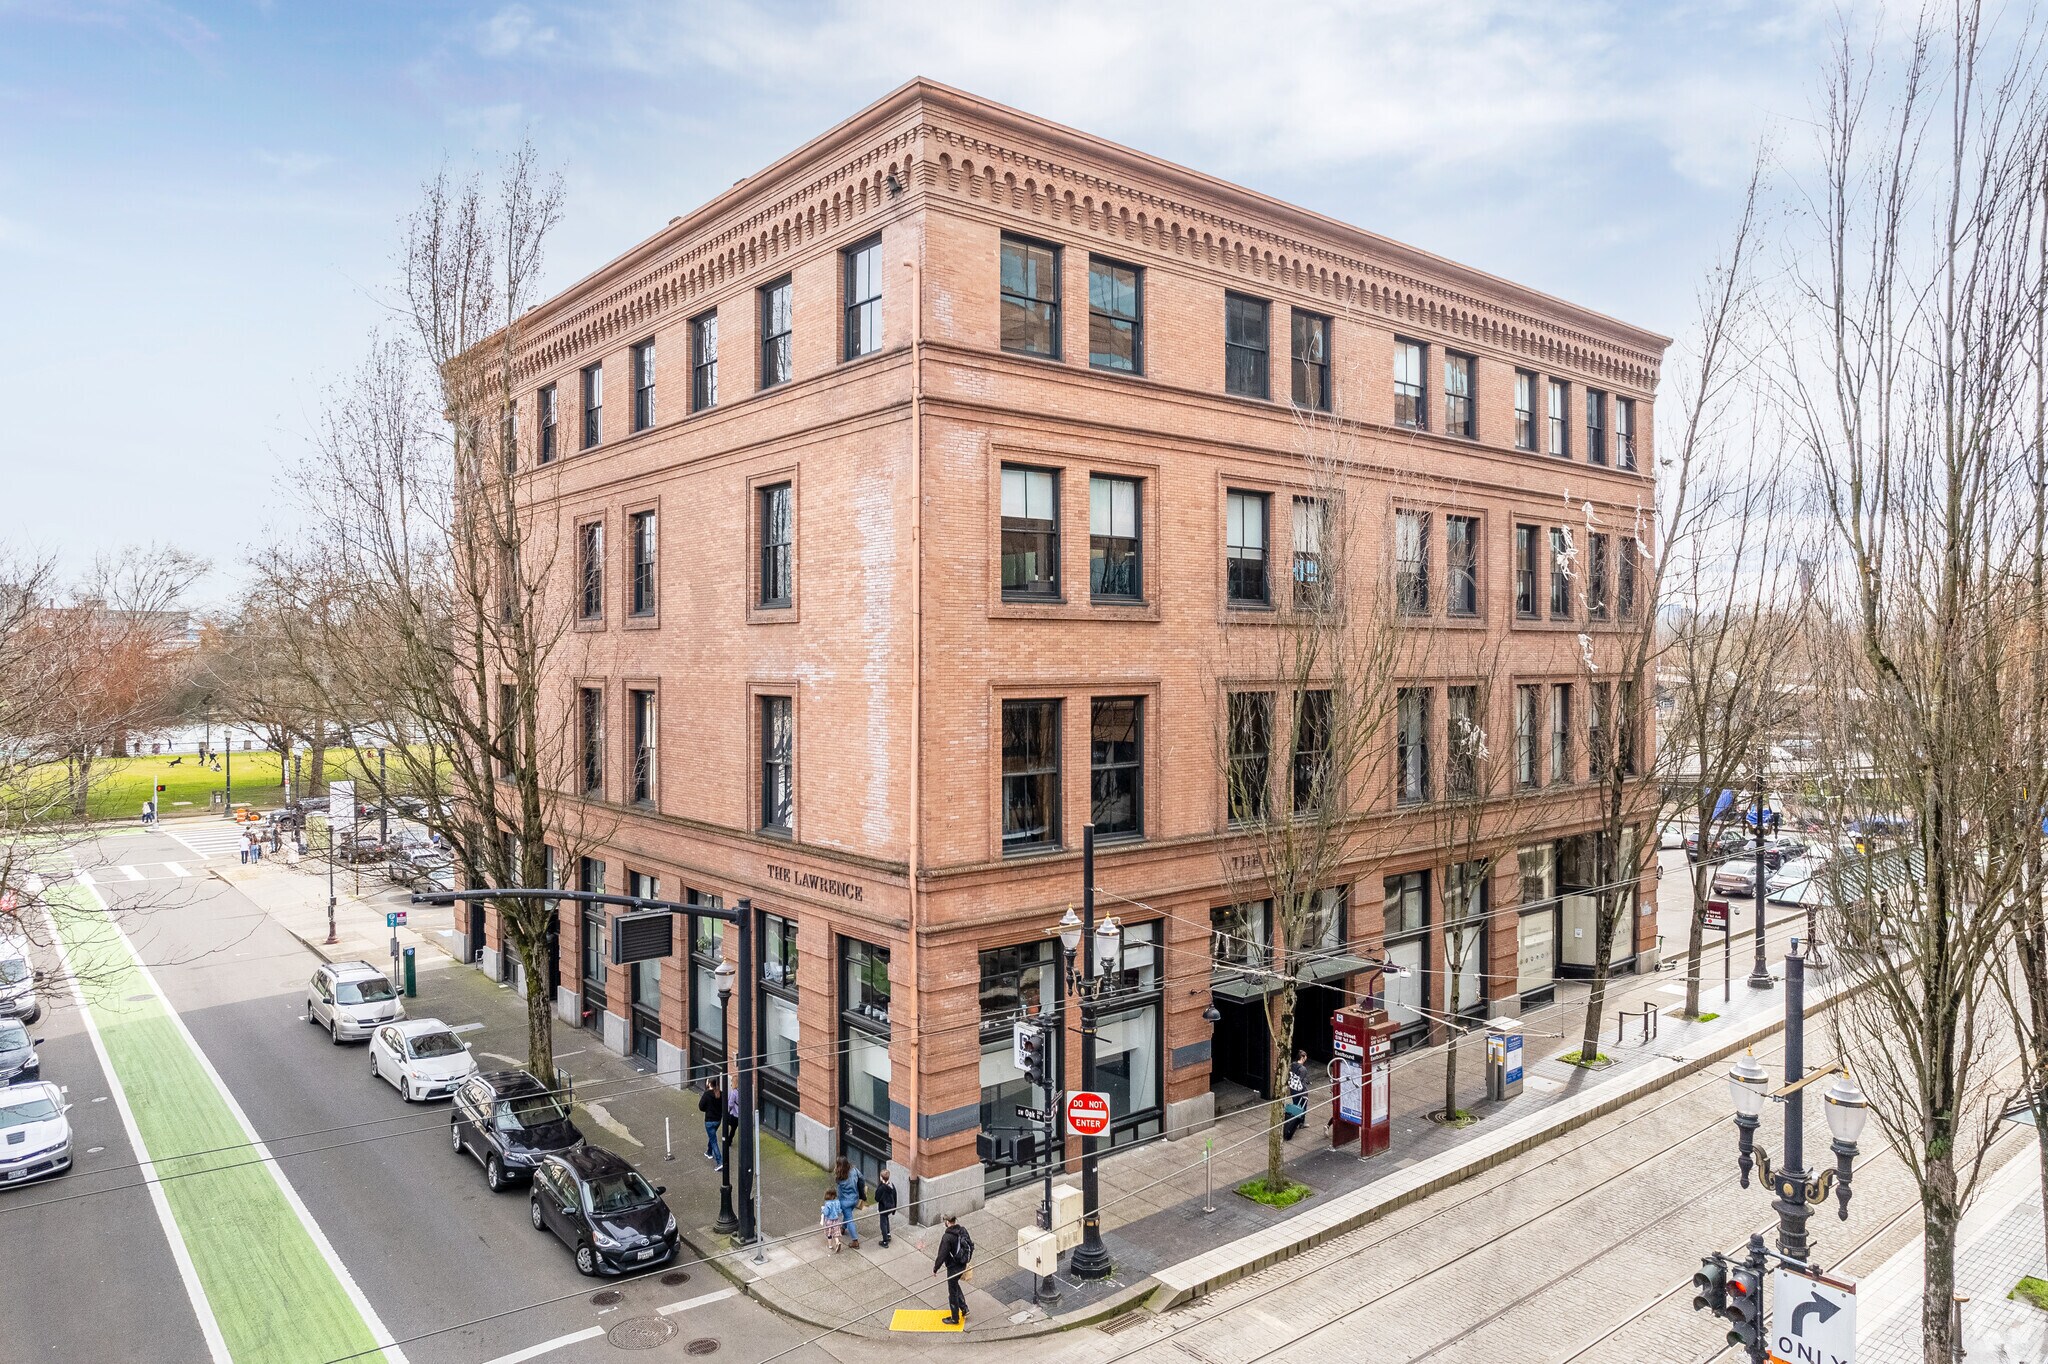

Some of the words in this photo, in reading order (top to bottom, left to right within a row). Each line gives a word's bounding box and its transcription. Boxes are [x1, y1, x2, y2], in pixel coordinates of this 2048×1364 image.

[767, 864, 791, 882] THE
[794, 870, 863, 902] LAWRENCE
[1343, 1032, 1356, 1040] Street
[1073, 1099, 1084, 1108] DO
[1088, 1100, 1103, 1109] NOT
[1024, 1109, 1036, 1118] Oak
[1075, 1119, 1101, 1128] ENTER
